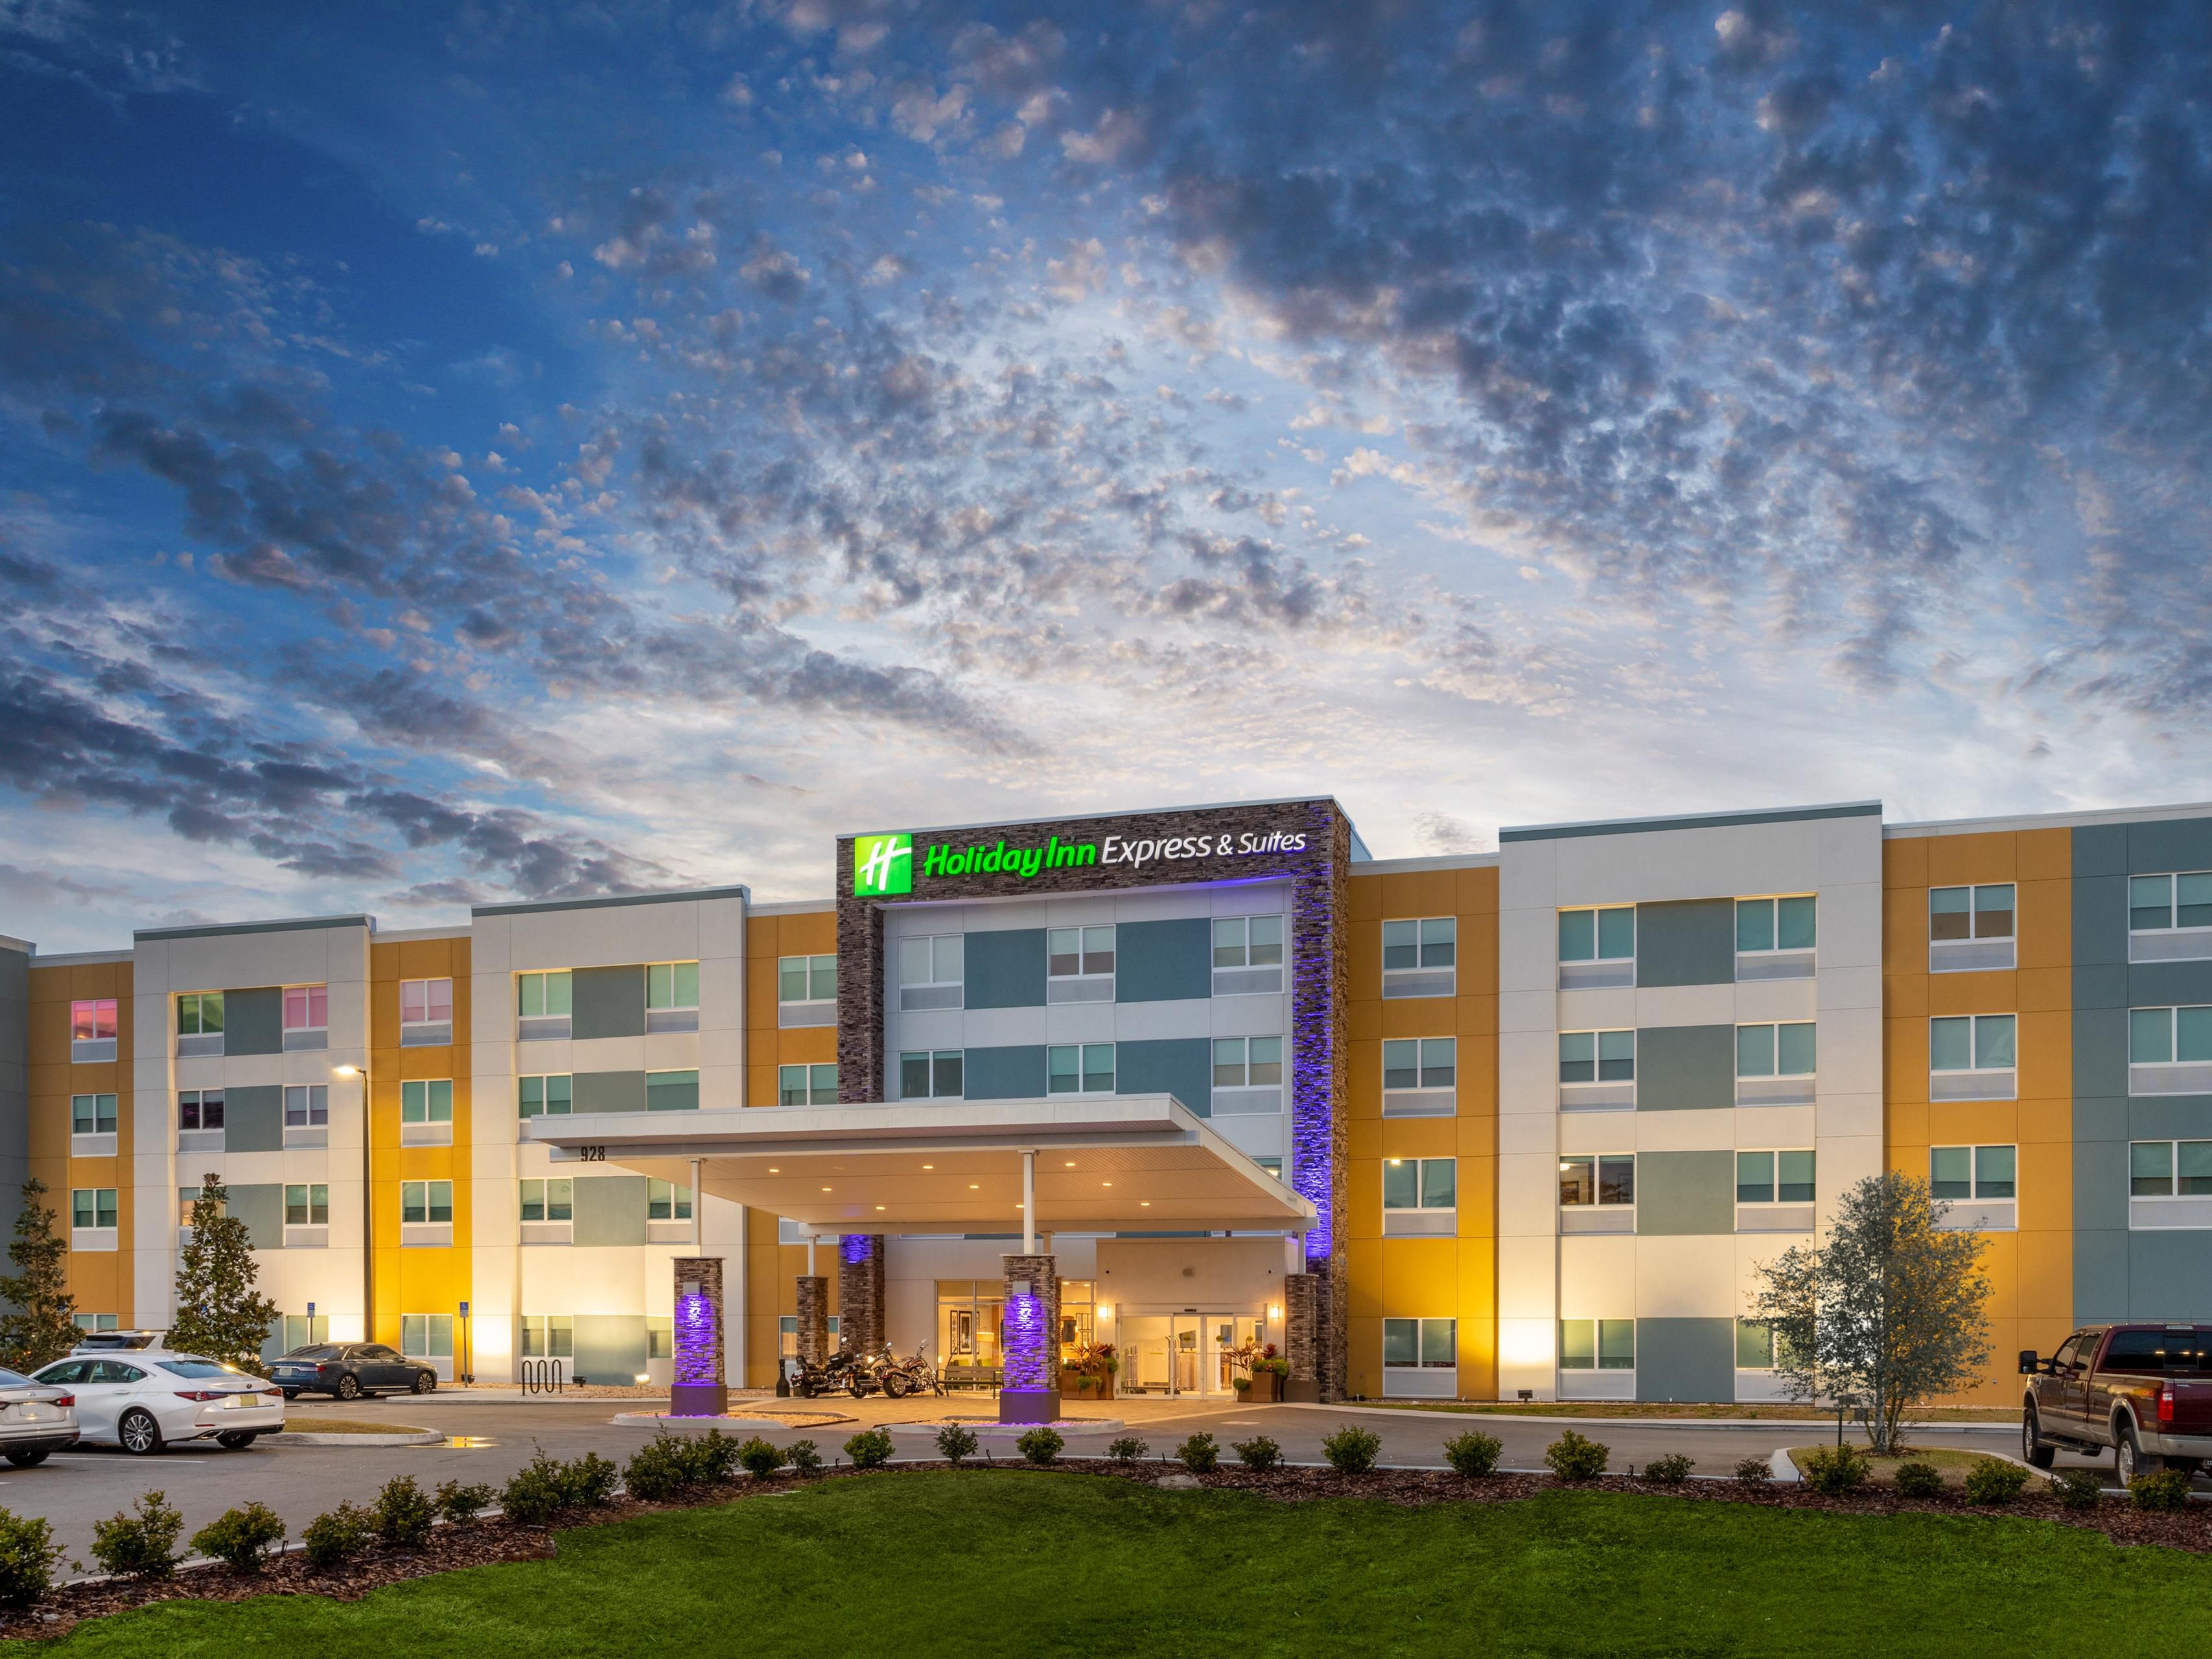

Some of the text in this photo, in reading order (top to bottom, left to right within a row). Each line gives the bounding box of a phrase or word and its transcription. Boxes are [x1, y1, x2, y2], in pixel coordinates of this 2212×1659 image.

[859, 837, 912, 891] H
[923, 830, 1307, 877] Holiday Inn Express & Suites
[581, 1146, 605, 1161] 928
